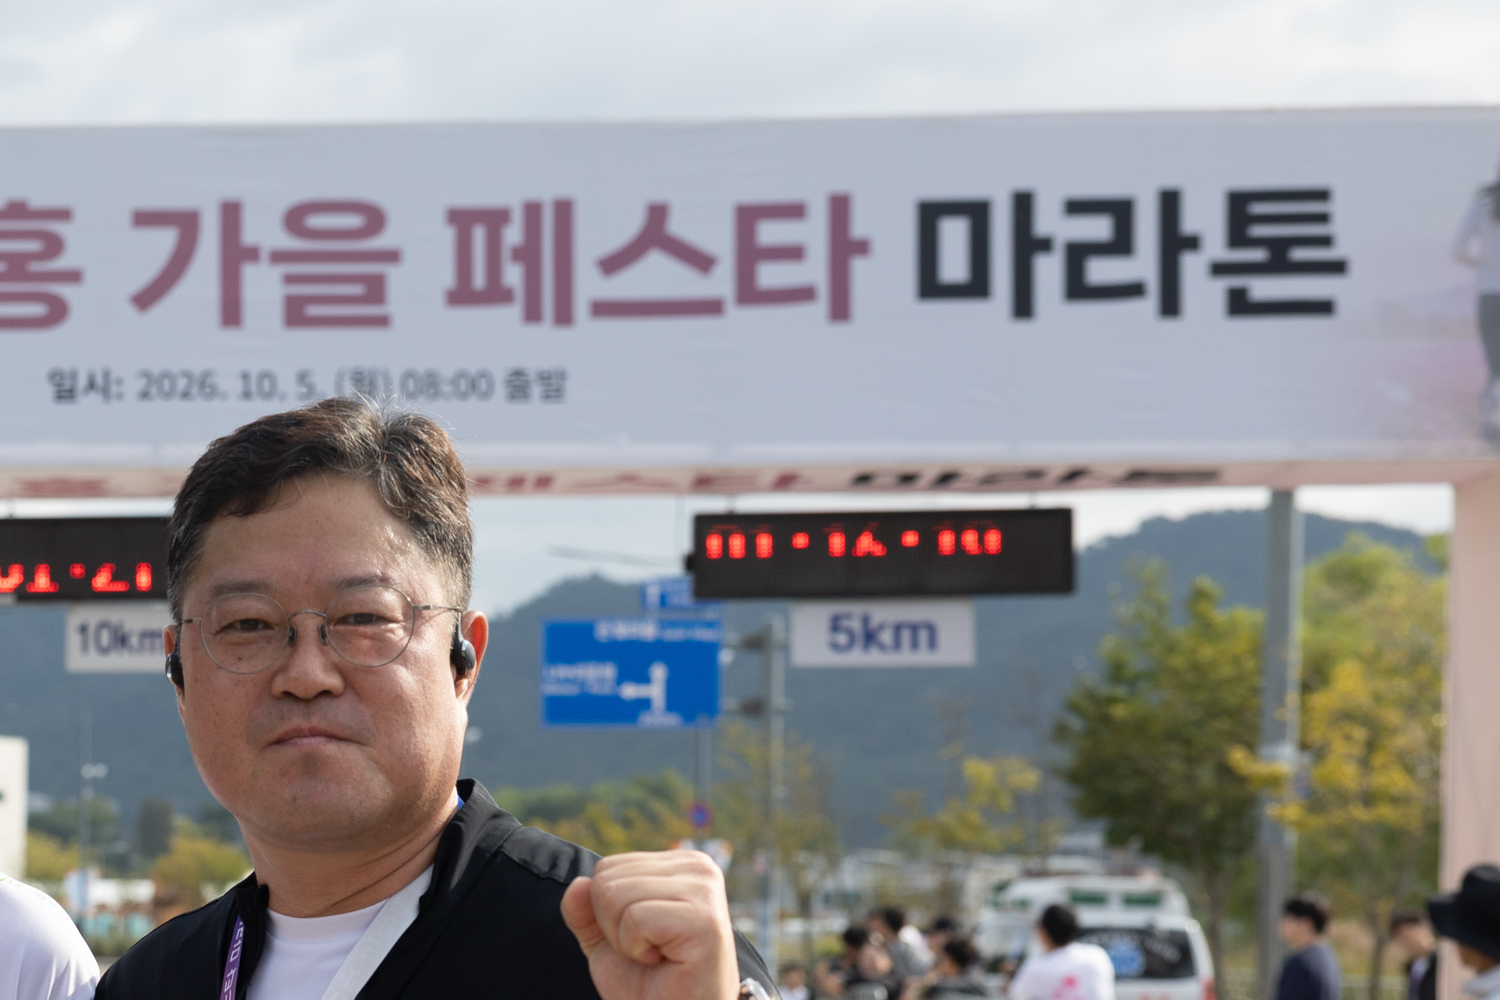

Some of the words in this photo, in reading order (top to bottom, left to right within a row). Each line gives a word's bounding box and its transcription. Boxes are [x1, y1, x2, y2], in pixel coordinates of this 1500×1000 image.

[130, 200, 401, 328] 가을
[446, 194, 871, 327] 페스타
[916, 189, 1349, 320] 마라톤
[47, 368, 124, 404] 일시:
[136, 369, 228, 403] 2026.
[504, 367, 568, 404] 출발
[828, 612, 938, 653] 5km
